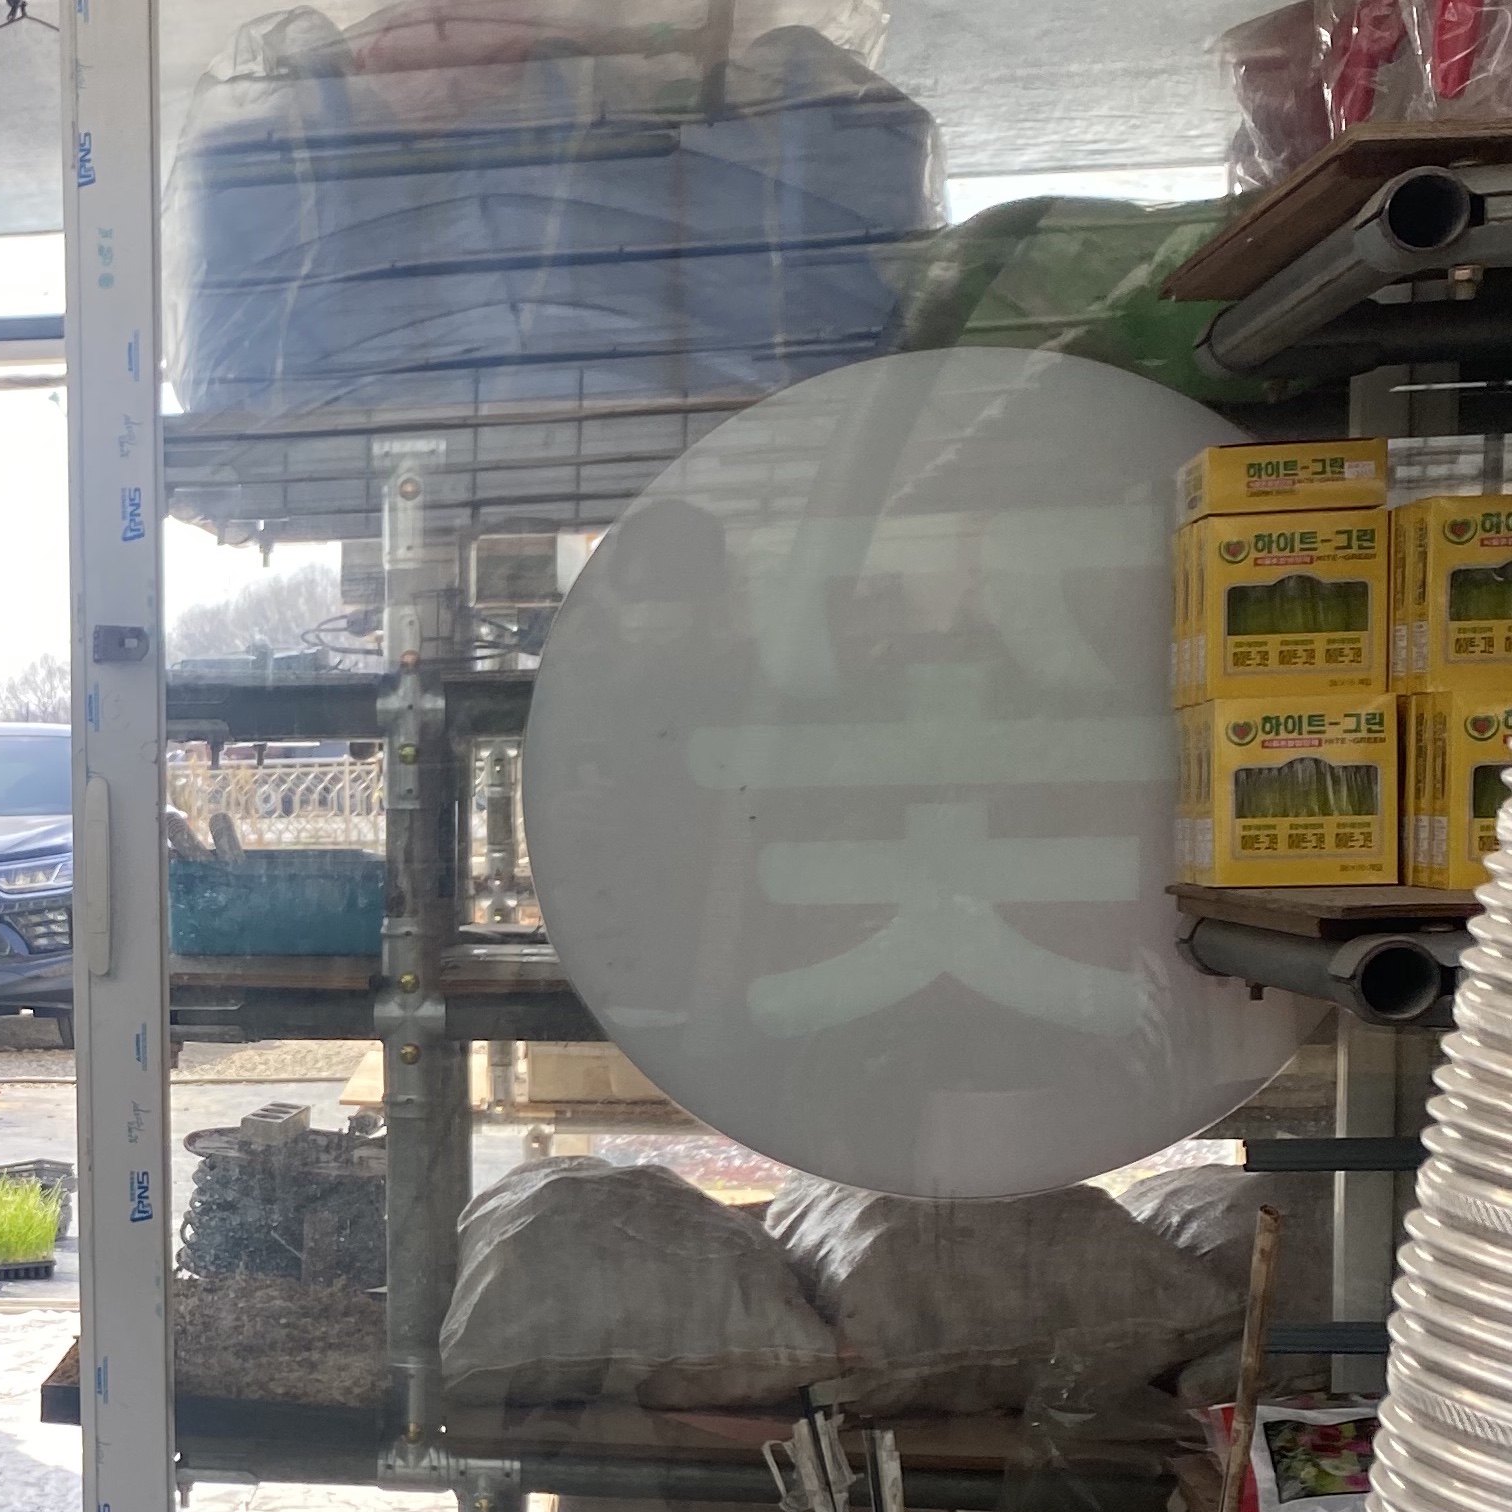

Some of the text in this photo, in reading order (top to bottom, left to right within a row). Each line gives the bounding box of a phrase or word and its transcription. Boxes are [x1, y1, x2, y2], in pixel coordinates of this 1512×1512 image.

[1246, 456, 1345, 479] 하이트-그린
[125, 487, 143, 540] PNS
[1254, 528, 1376, 555] 하이트-그린
[1261, 711, 1385, 736] 하이트-그린
[130, 1171, 151, 1221] PNS
